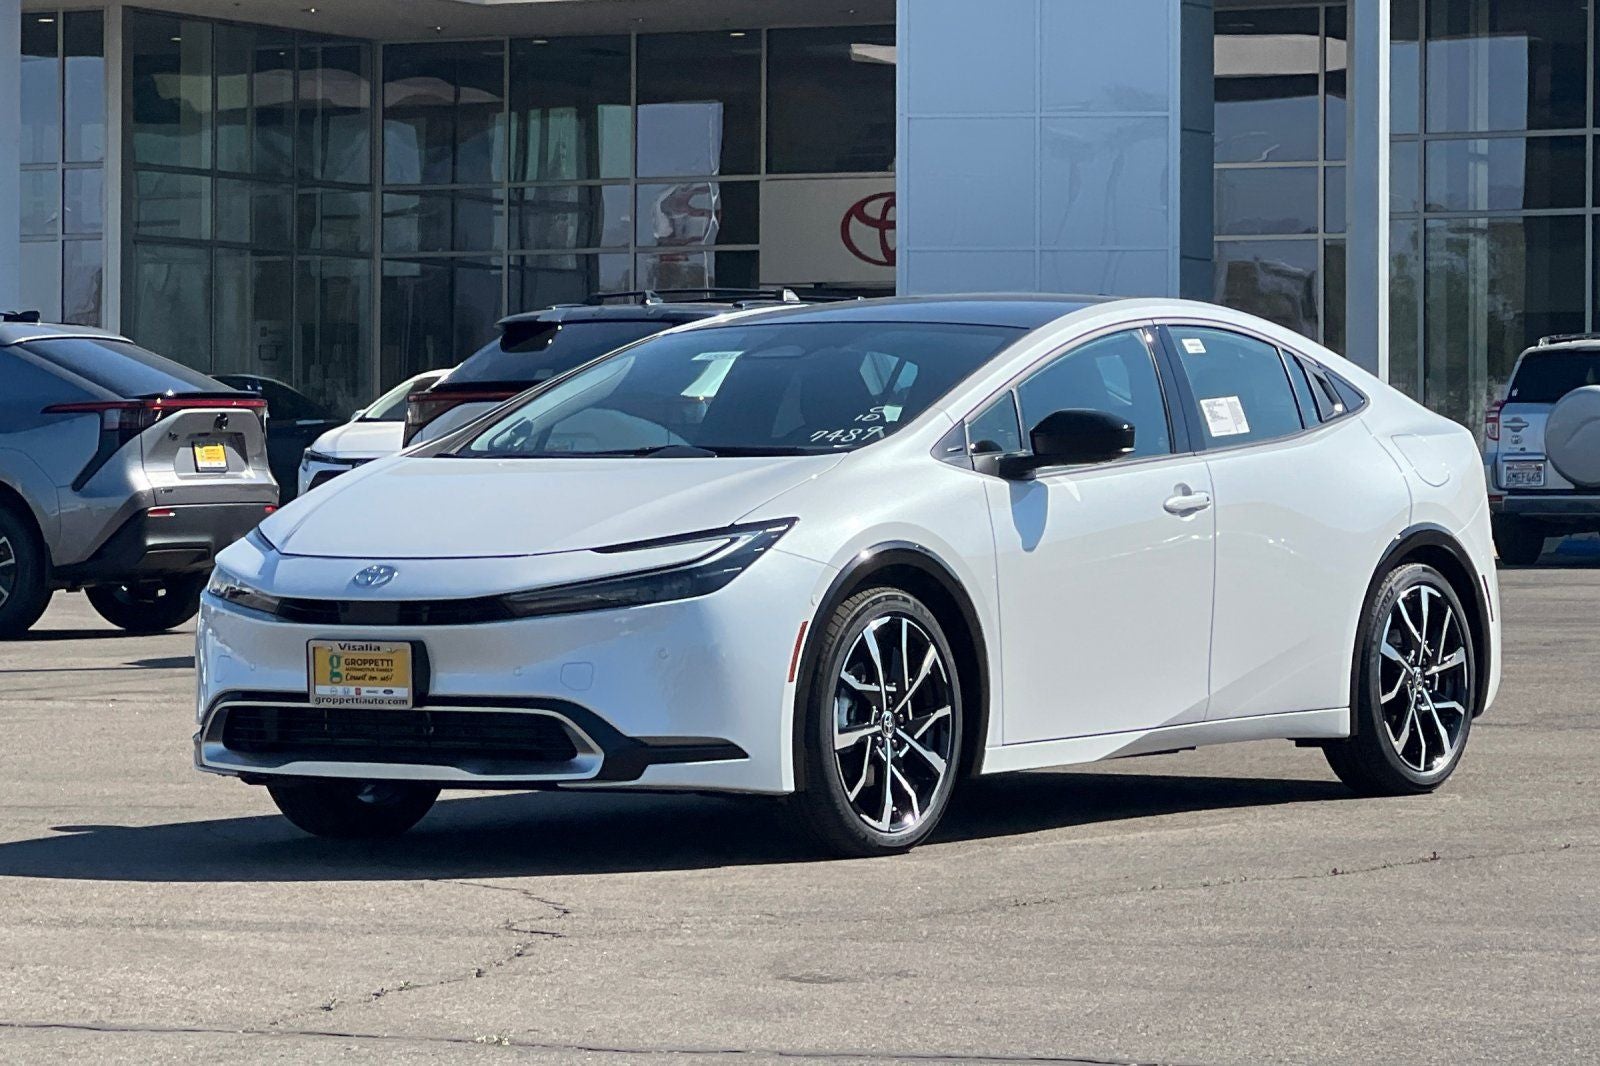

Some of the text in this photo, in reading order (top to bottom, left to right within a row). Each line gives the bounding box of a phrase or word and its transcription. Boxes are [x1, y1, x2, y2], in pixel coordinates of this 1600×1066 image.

[810, 426, 884, 442] 7489
[338, 643, 381, 652] Visalia
[344, 658, 394, 667] GROPPETTI
[345, 672, 367, 681] Count
[315, 697, 408, 706] groppettiauto.com
